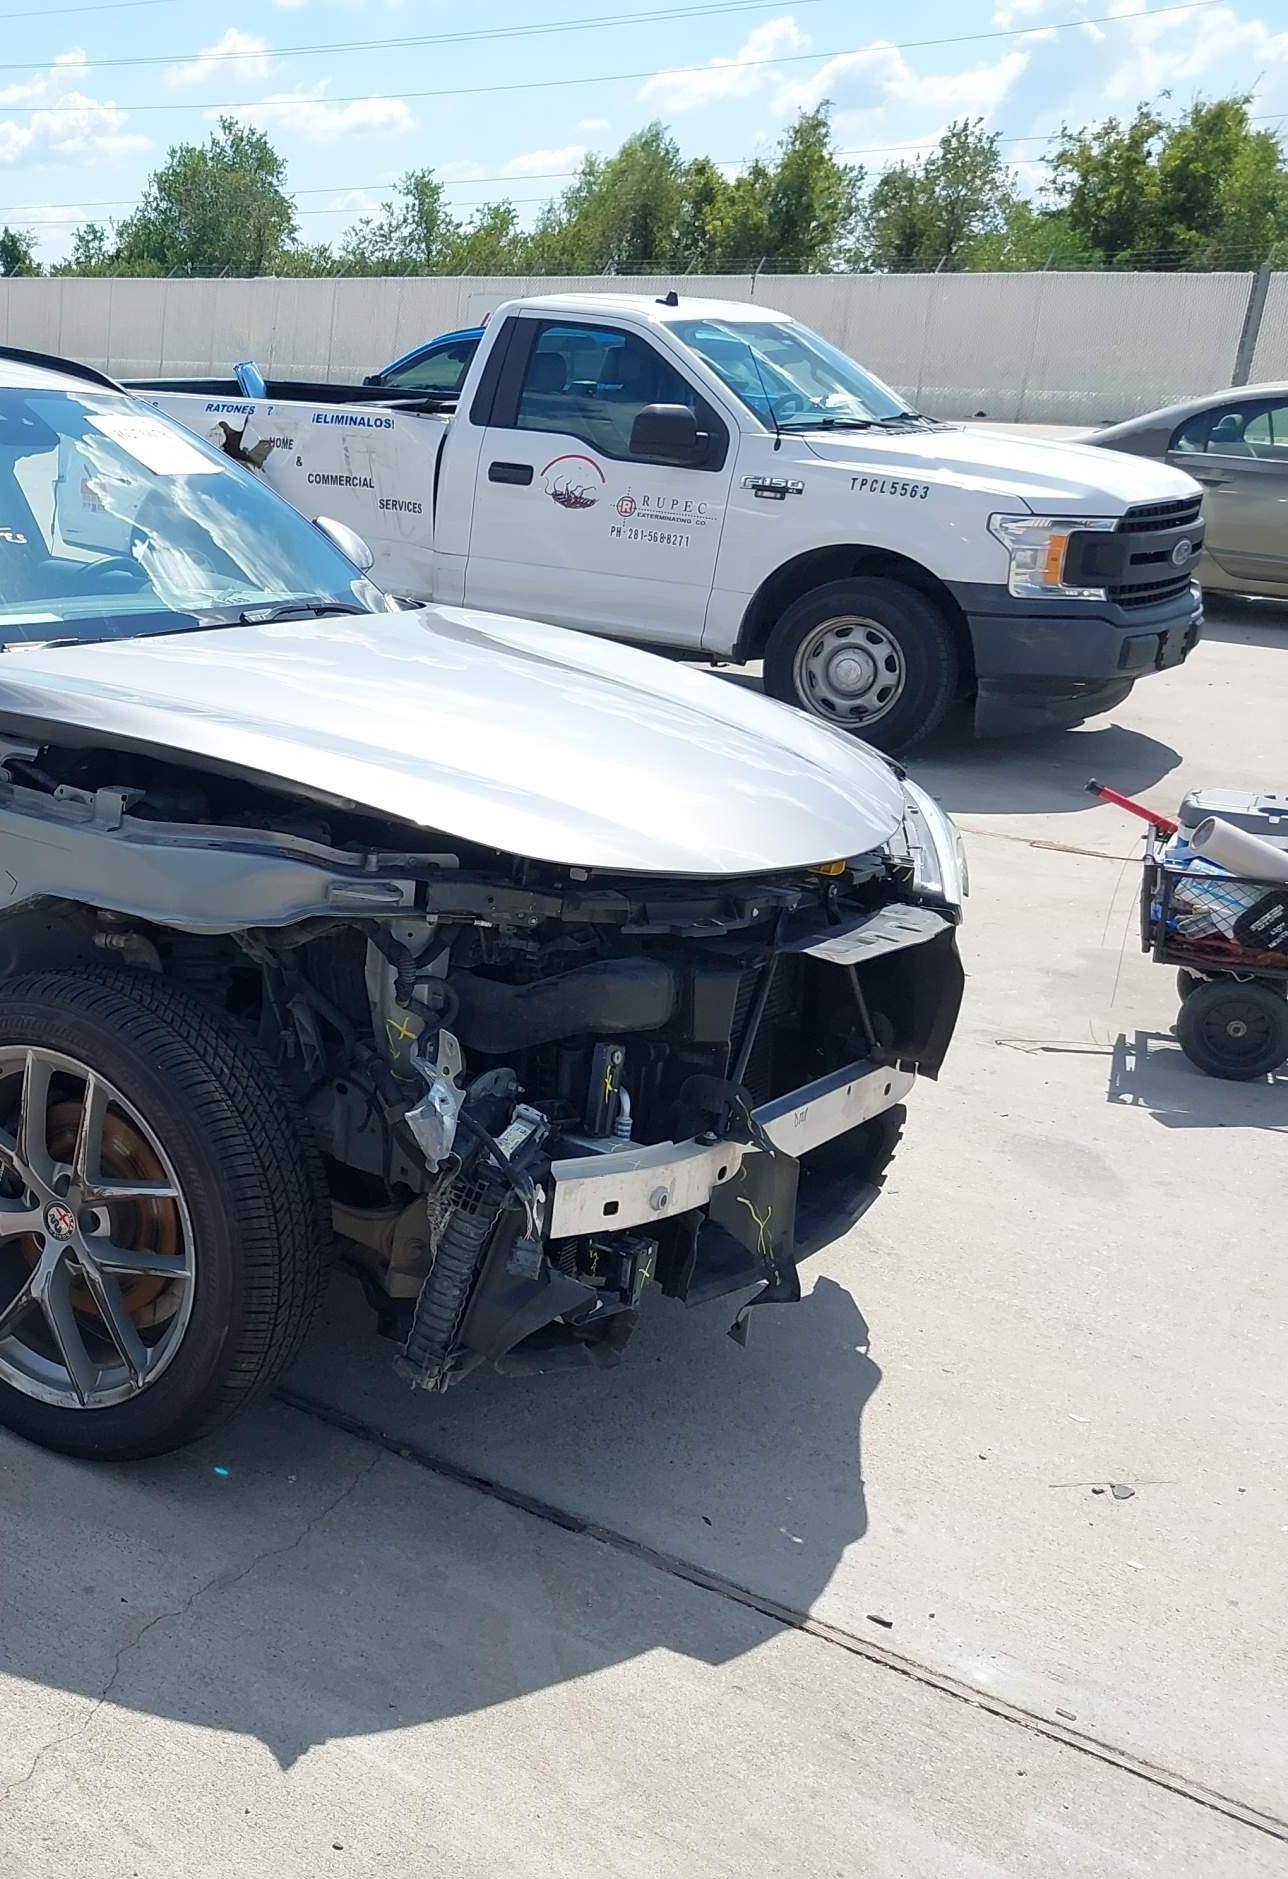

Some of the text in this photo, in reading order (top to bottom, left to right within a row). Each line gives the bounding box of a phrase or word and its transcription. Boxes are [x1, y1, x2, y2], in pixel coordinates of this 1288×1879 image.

[205, 403, 274, 416] RATONES ?
[269, 436, 294, 450] HOME
[295, 455, 303, 467] &
[307, 473, 375, 489] COMMERCIAL
[850, 477, 930, 499] TPCL5563
[378, 498, 423, 514] SERVICES
[642, 495, 707, 515] RUPEC
[637, 511, 692, 524] EXTERMINATING
